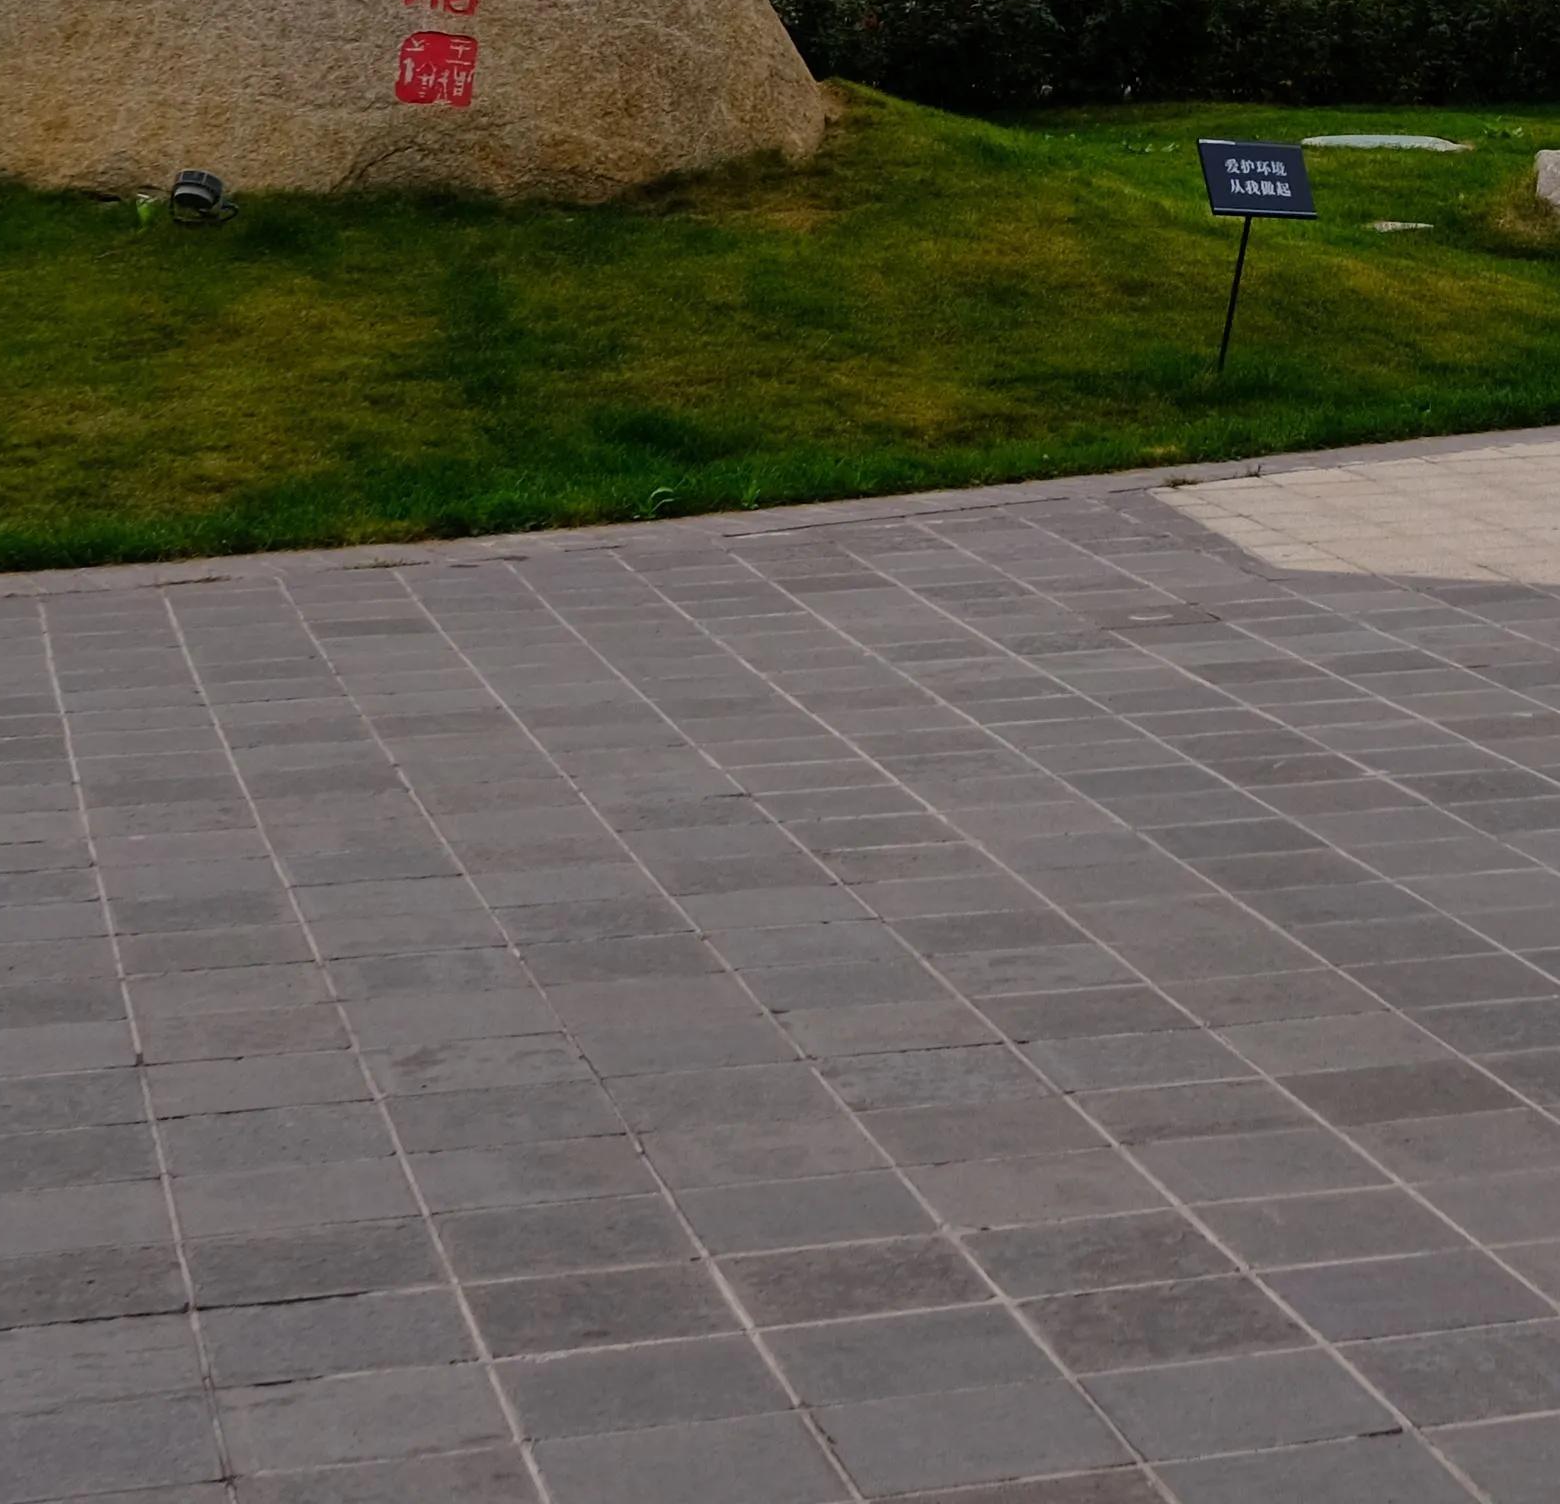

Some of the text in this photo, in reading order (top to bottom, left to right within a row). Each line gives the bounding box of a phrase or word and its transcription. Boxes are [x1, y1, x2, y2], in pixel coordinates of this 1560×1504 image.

[1224, 158, 1287, 176] 爱护环境
[1230, 179, 1291, 197] 从我做起
